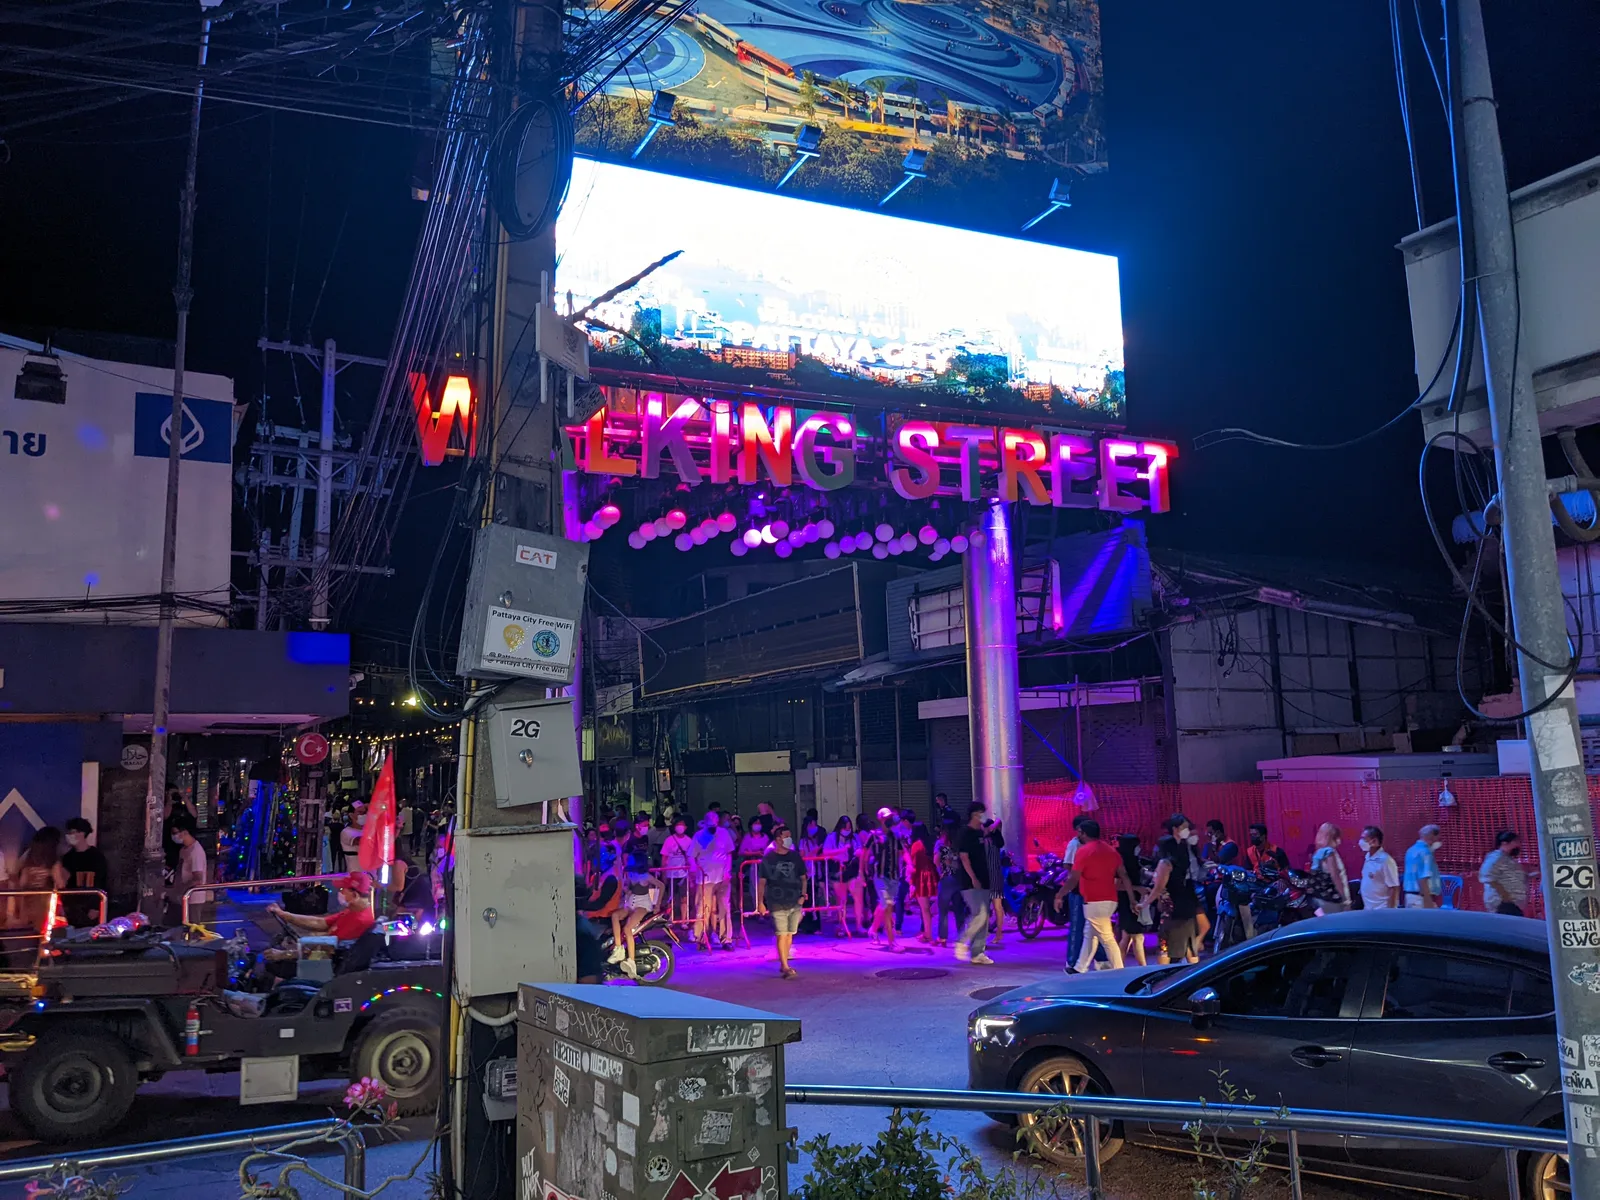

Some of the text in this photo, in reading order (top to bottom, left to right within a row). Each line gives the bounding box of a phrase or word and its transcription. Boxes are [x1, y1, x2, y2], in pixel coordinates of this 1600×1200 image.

[730, 320, 876, 364] PATTAYA
[888, 420, 1180, 514] STREET
[519, 549, 553, 565] CAT
[492, 609, 572, 630] Pattaya City Free WiFi
[496, 659, 566, 674] Pattaya City Free WiFi
[510, 719, 540, 739] 2G
[1558, 840, 1589, 858] CHAO
[1554, 865, 1594, 889] 2G
